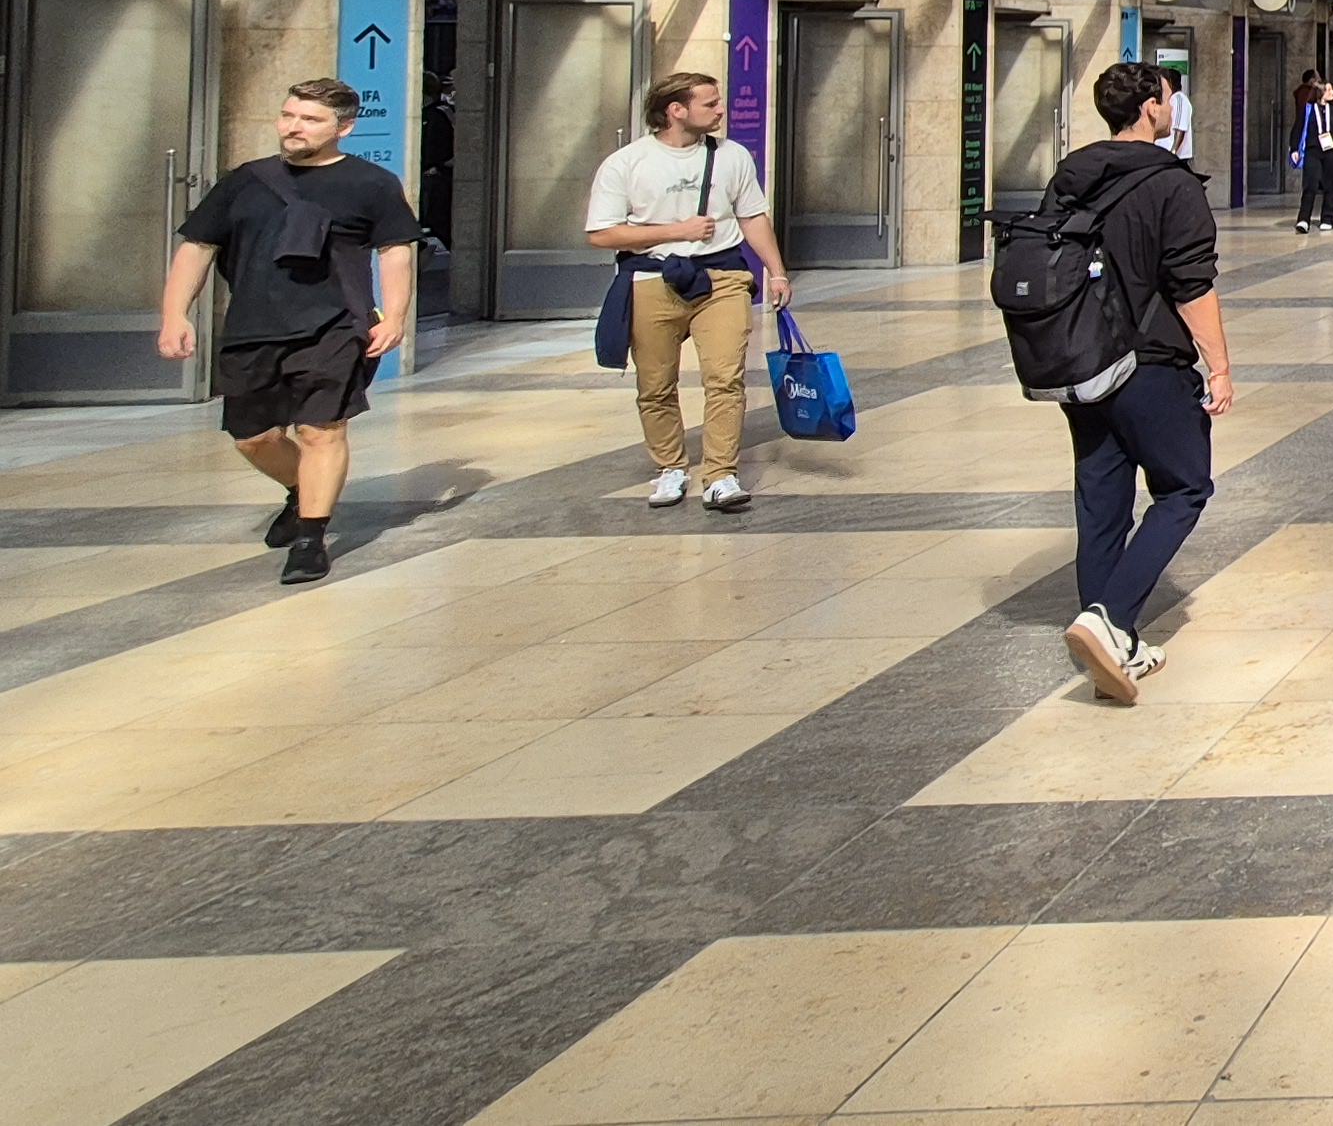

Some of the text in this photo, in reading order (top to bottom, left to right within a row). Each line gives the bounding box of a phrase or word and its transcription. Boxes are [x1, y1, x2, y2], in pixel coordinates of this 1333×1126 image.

[362, 90, 381, 102] IFA
[358, 106, 387, 118] Zone
[373, 150, 392, 163] 5.2
